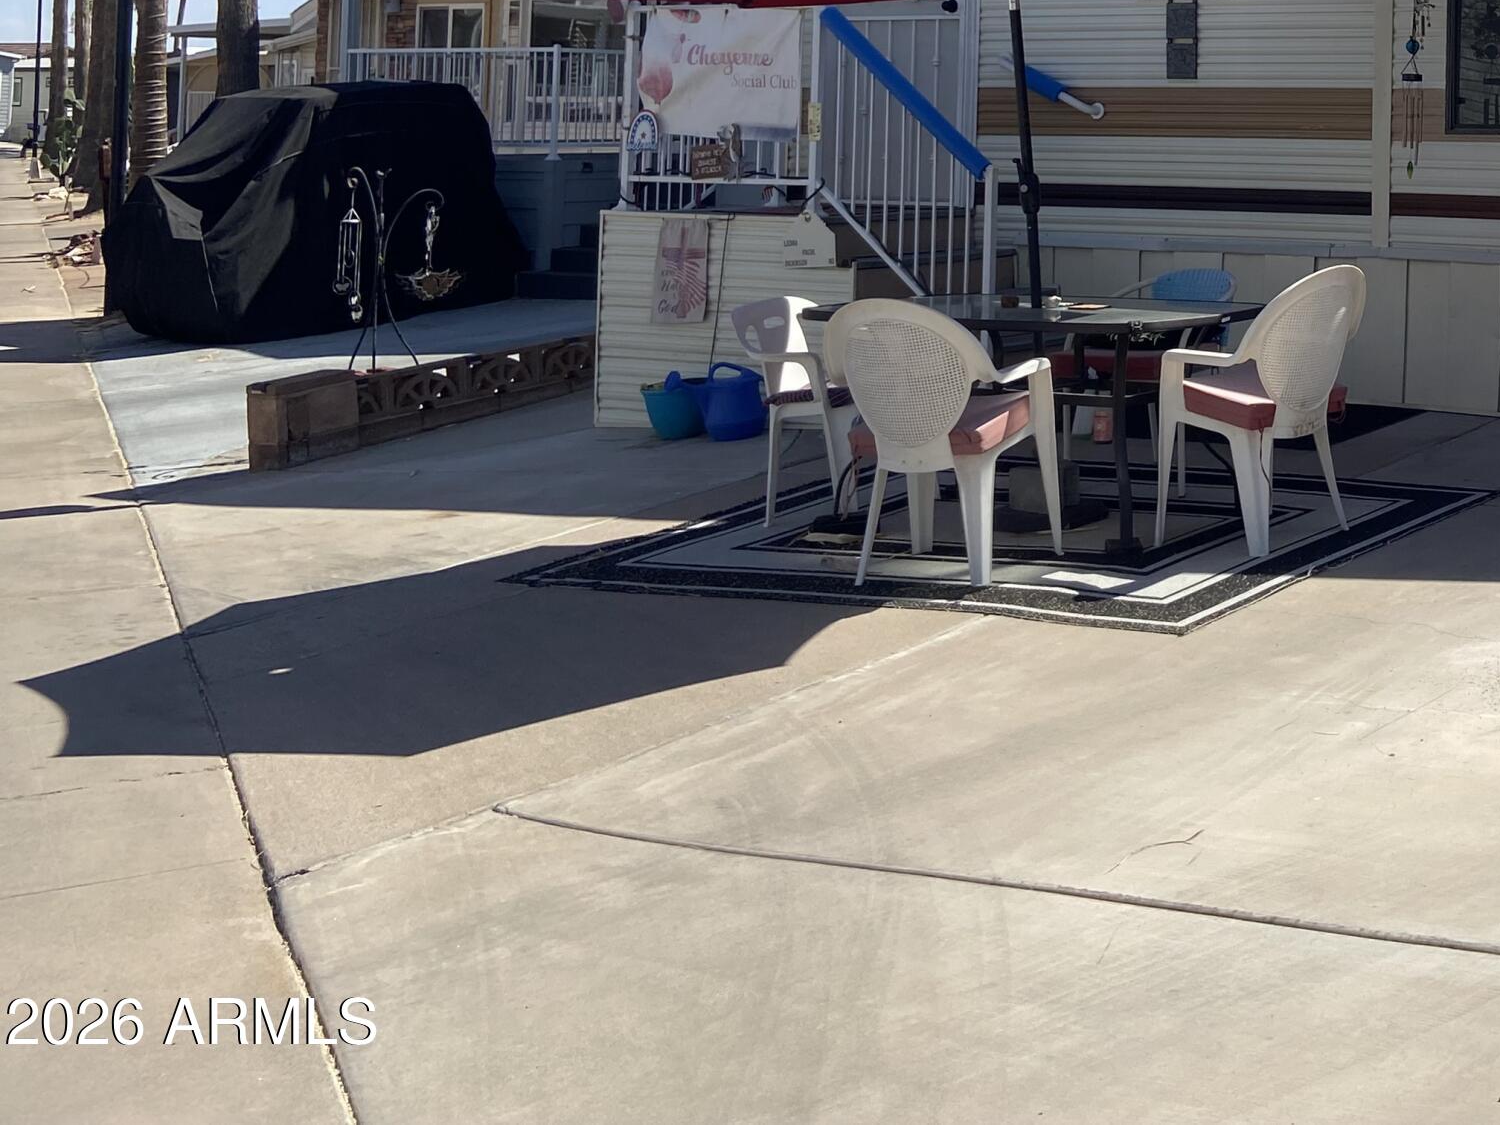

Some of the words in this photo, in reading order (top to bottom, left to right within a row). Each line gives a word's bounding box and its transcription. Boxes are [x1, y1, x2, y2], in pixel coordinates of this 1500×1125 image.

[687, 43, 774, 75] Cheyenne
[730, 74, 767, 88] Social
[769, 75, 798, 90] Club
